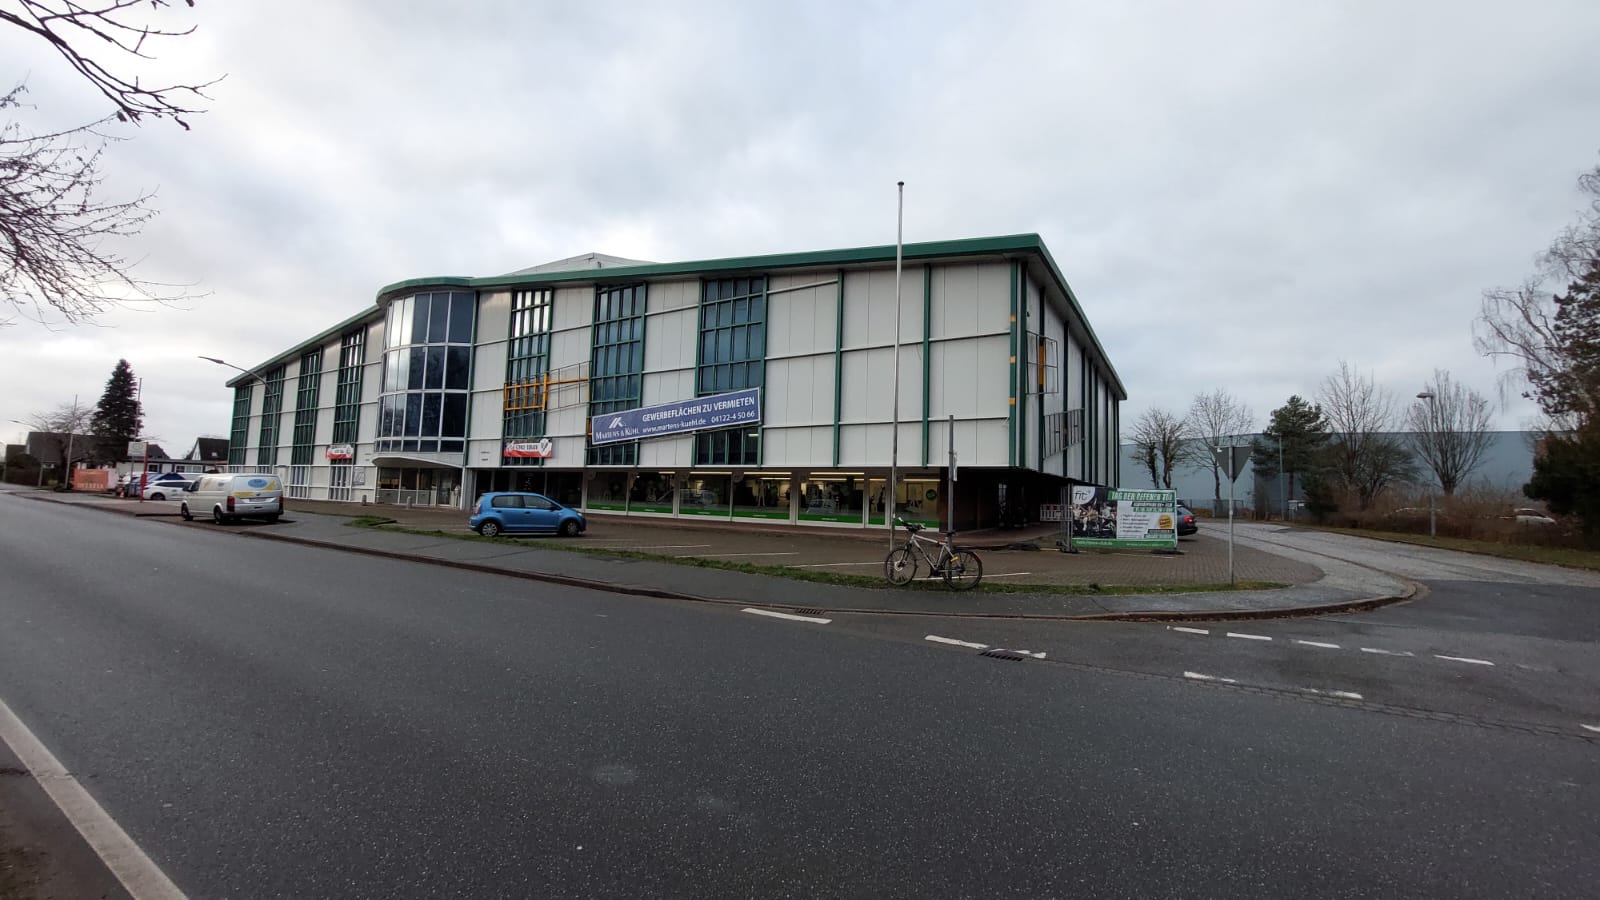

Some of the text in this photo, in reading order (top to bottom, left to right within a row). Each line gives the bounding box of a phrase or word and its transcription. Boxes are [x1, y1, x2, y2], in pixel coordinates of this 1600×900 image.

[642, 397, 754, 422] GEWERBEFLÄCHEN ZU VERMIETEN
[642, 419, 706, 433] www.martens-kuehl.de
